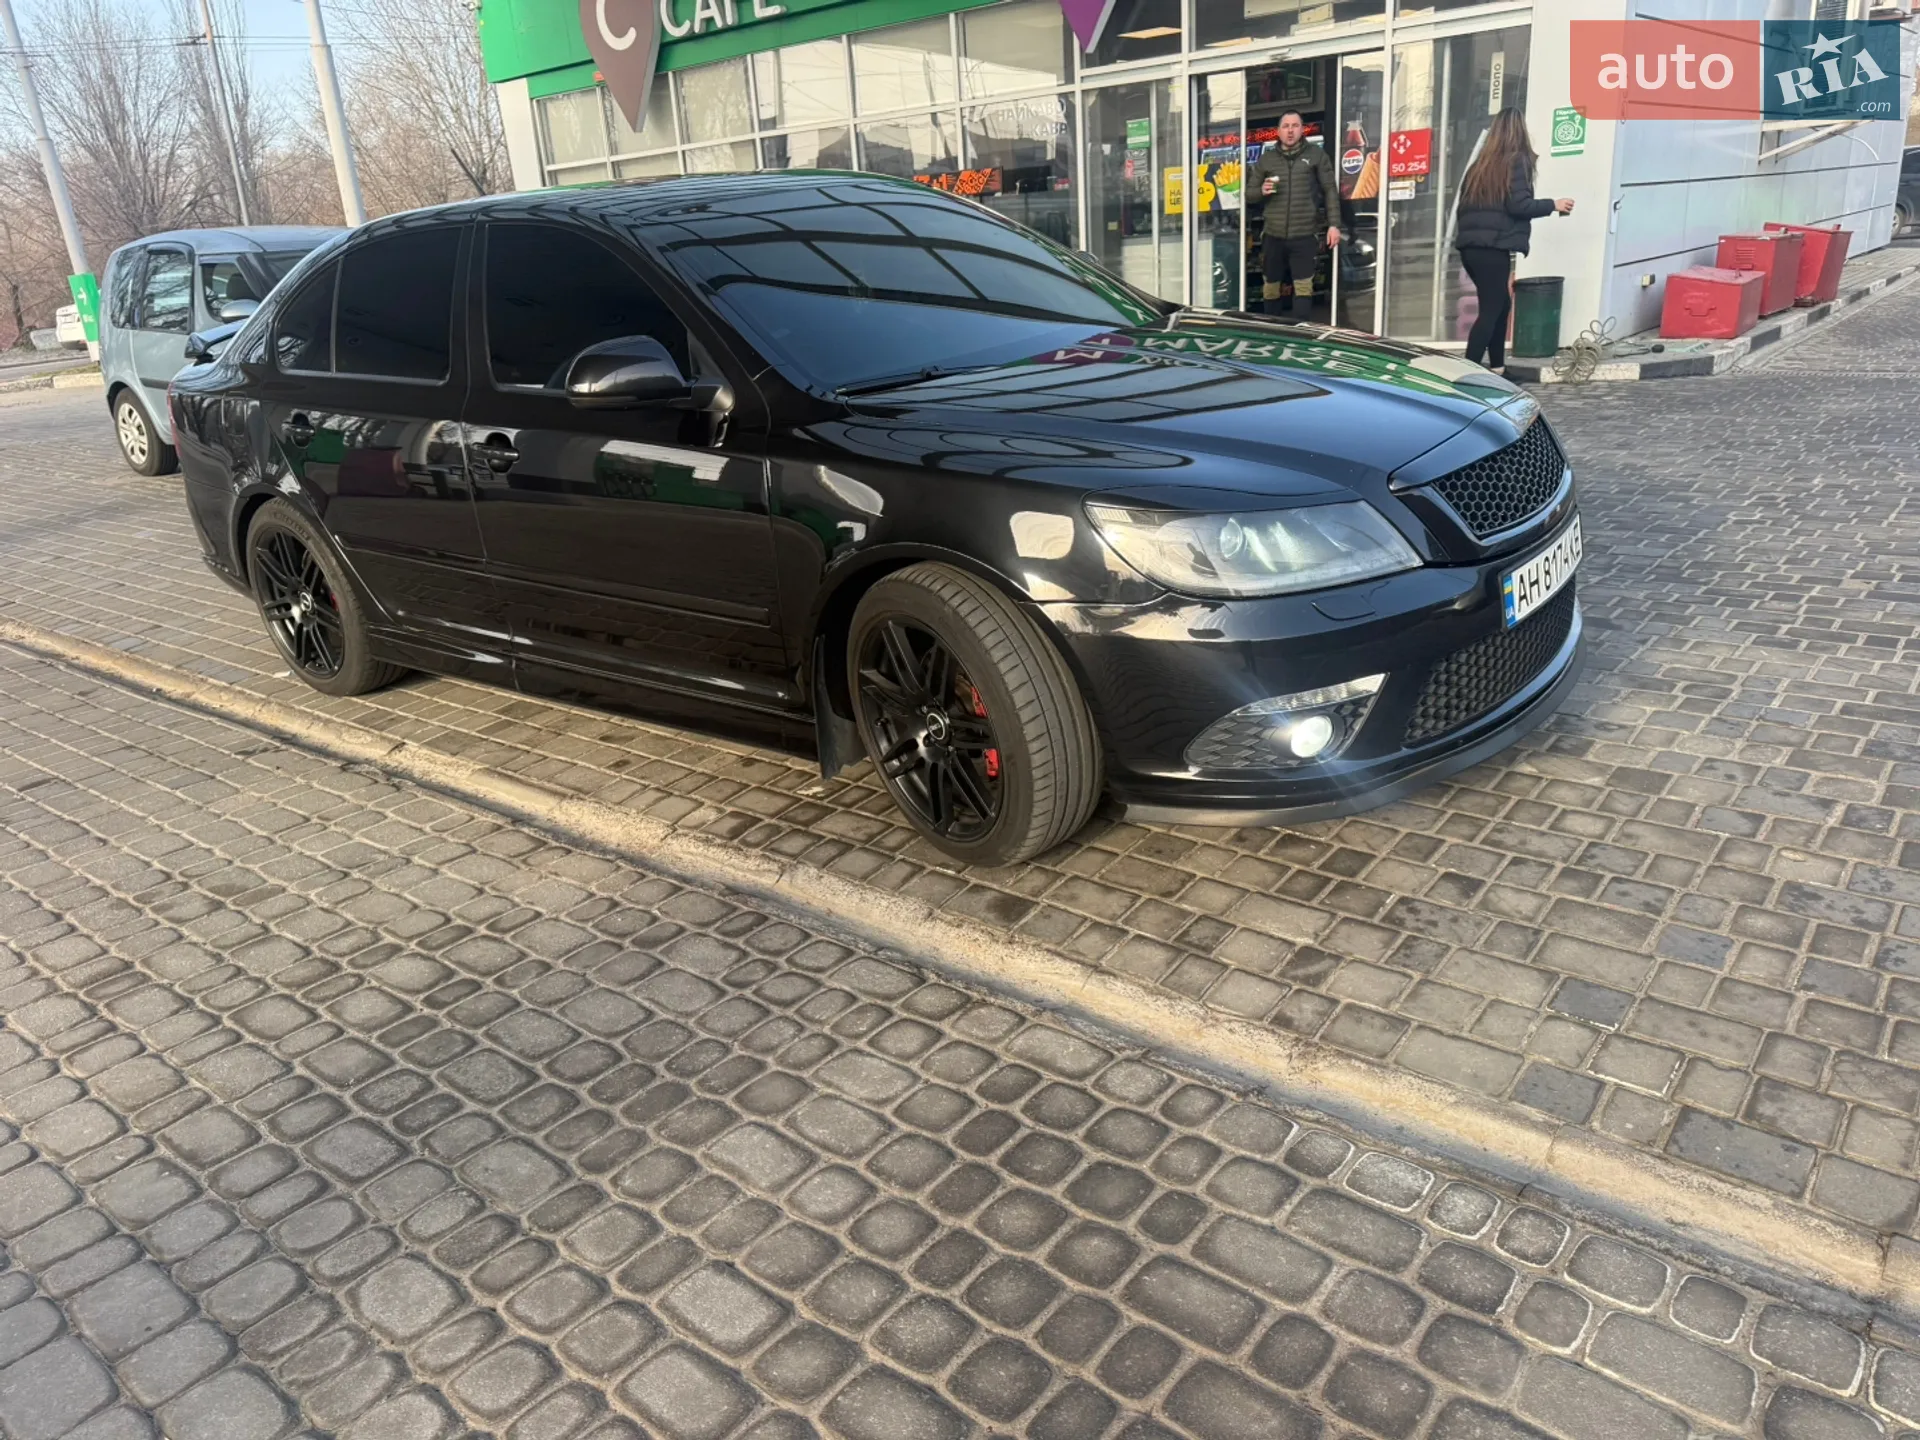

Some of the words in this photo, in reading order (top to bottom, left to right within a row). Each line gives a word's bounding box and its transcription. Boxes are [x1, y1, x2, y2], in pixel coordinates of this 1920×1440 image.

[1492, 63, 1502, 100] mono
[1391, 163, 1406, 173] 50
[1407, 160, 1427, 172] 254
[1518, 562, 1541, 613] AH
